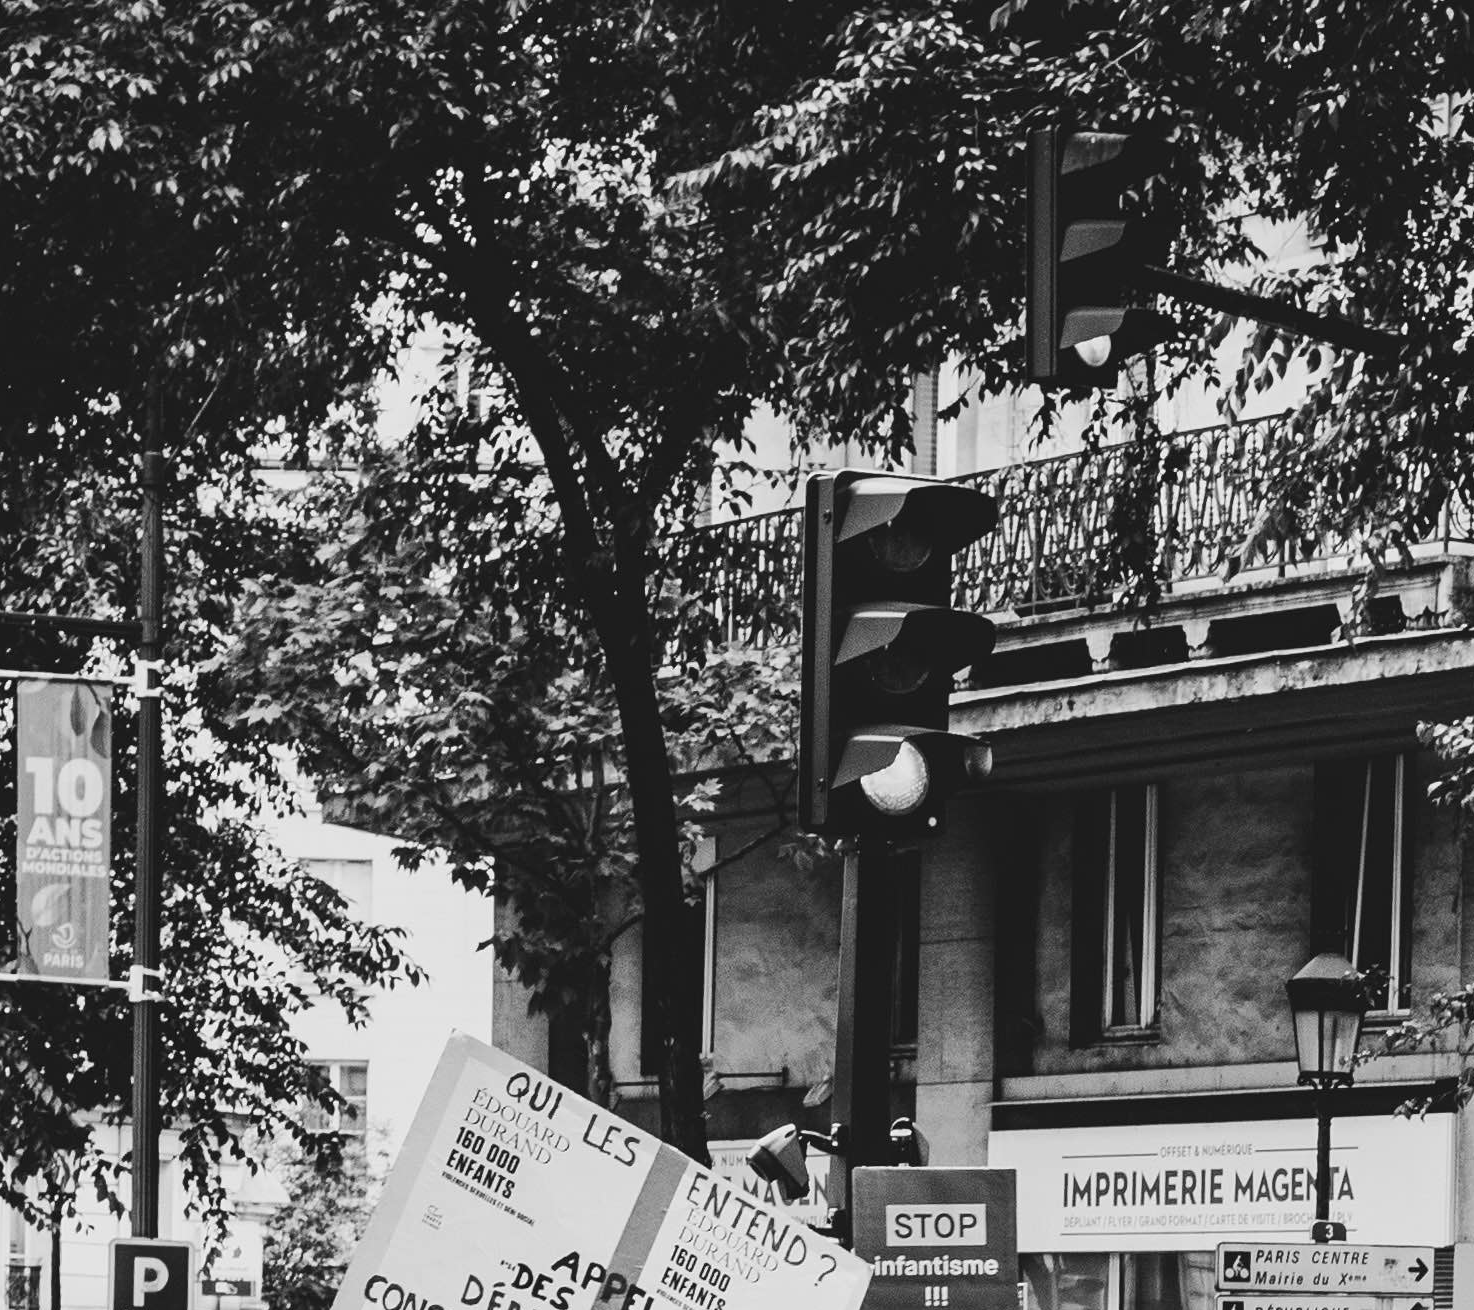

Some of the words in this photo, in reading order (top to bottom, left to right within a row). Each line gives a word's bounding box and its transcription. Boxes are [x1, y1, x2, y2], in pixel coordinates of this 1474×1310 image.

[25, 757, 103, 817] 10
[26, 816, 103, 849] ANS
[22, 860, 107, 878] MONDIALES
[26, 847, 103, 863] D'ACTIONS
[43, 953, 85, 969] PARIS
[464, 1107, 553, 1166] DURAND
[472, 1087, 571, 1154] ÉDOUARD
[506, 1071, 564, 1120] QUI
[582, 1113, 641, 1168] LES
[455, 1126, 485, 1155] 160
[486, 1145, 521, 1175] 000
[1159, 1145, 1193, 1160] OFFSET
[1201, 1143, 1254, 1158] NUMÉRIQUE
[446, 1149, 516, 1200] ENFANTS
[1062, 1167, 1225, 1208] IMPRIMERIE
[687, 1171, 808, 1266] ENTEND
[894, 1212, 978, 1239] STOP
[1209, 1212, 1237, 1226] CARTE
[1238, 1212, 1250, 1225] DE
[1325, 1224, 1334, 1239] 3
[670, 1244, 698, 1273] 160
[698, 1262, 731, 1293] 000
[678, 1226, 761, 1284] DURAND
[873, 1254, 1000, 1277] infantisme
[1255, 1250, 1301, 1265] PARIS
[1311, 1250, 1370, 1265] CENTRE
[132, 1255, 170, 1308] P
[511, 1262, 575, 1310] DES
[1254, 1271, 1304, 1285] Mairie
[1313, 1272, 1330, 1285] du
